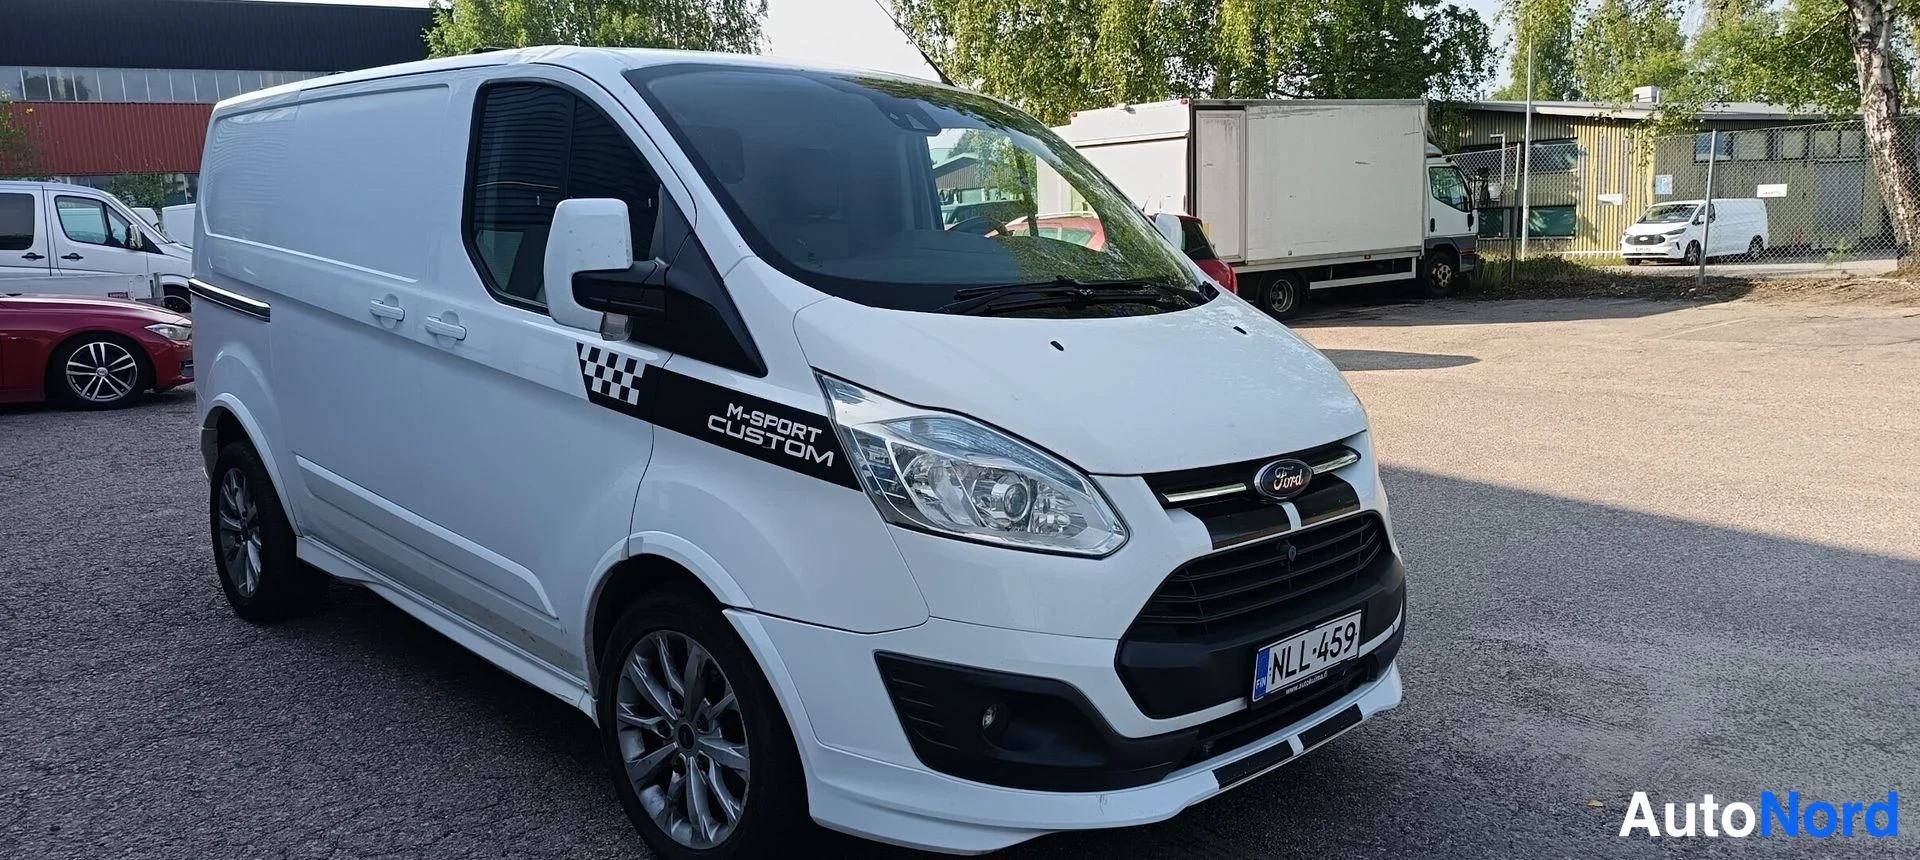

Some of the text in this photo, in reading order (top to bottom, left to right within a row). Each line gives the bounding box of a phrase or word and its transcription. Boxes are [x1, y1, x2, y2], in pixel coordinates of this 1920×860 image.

[708, 415, 834, 467] CUSTOM
[727, 403, 822, 443] M-SPORT
[1273, 466, 1304, 490] Ford
[1271, 622, 1356, 684] NLL-459
[1256, 677, 1267, 689] FIN
